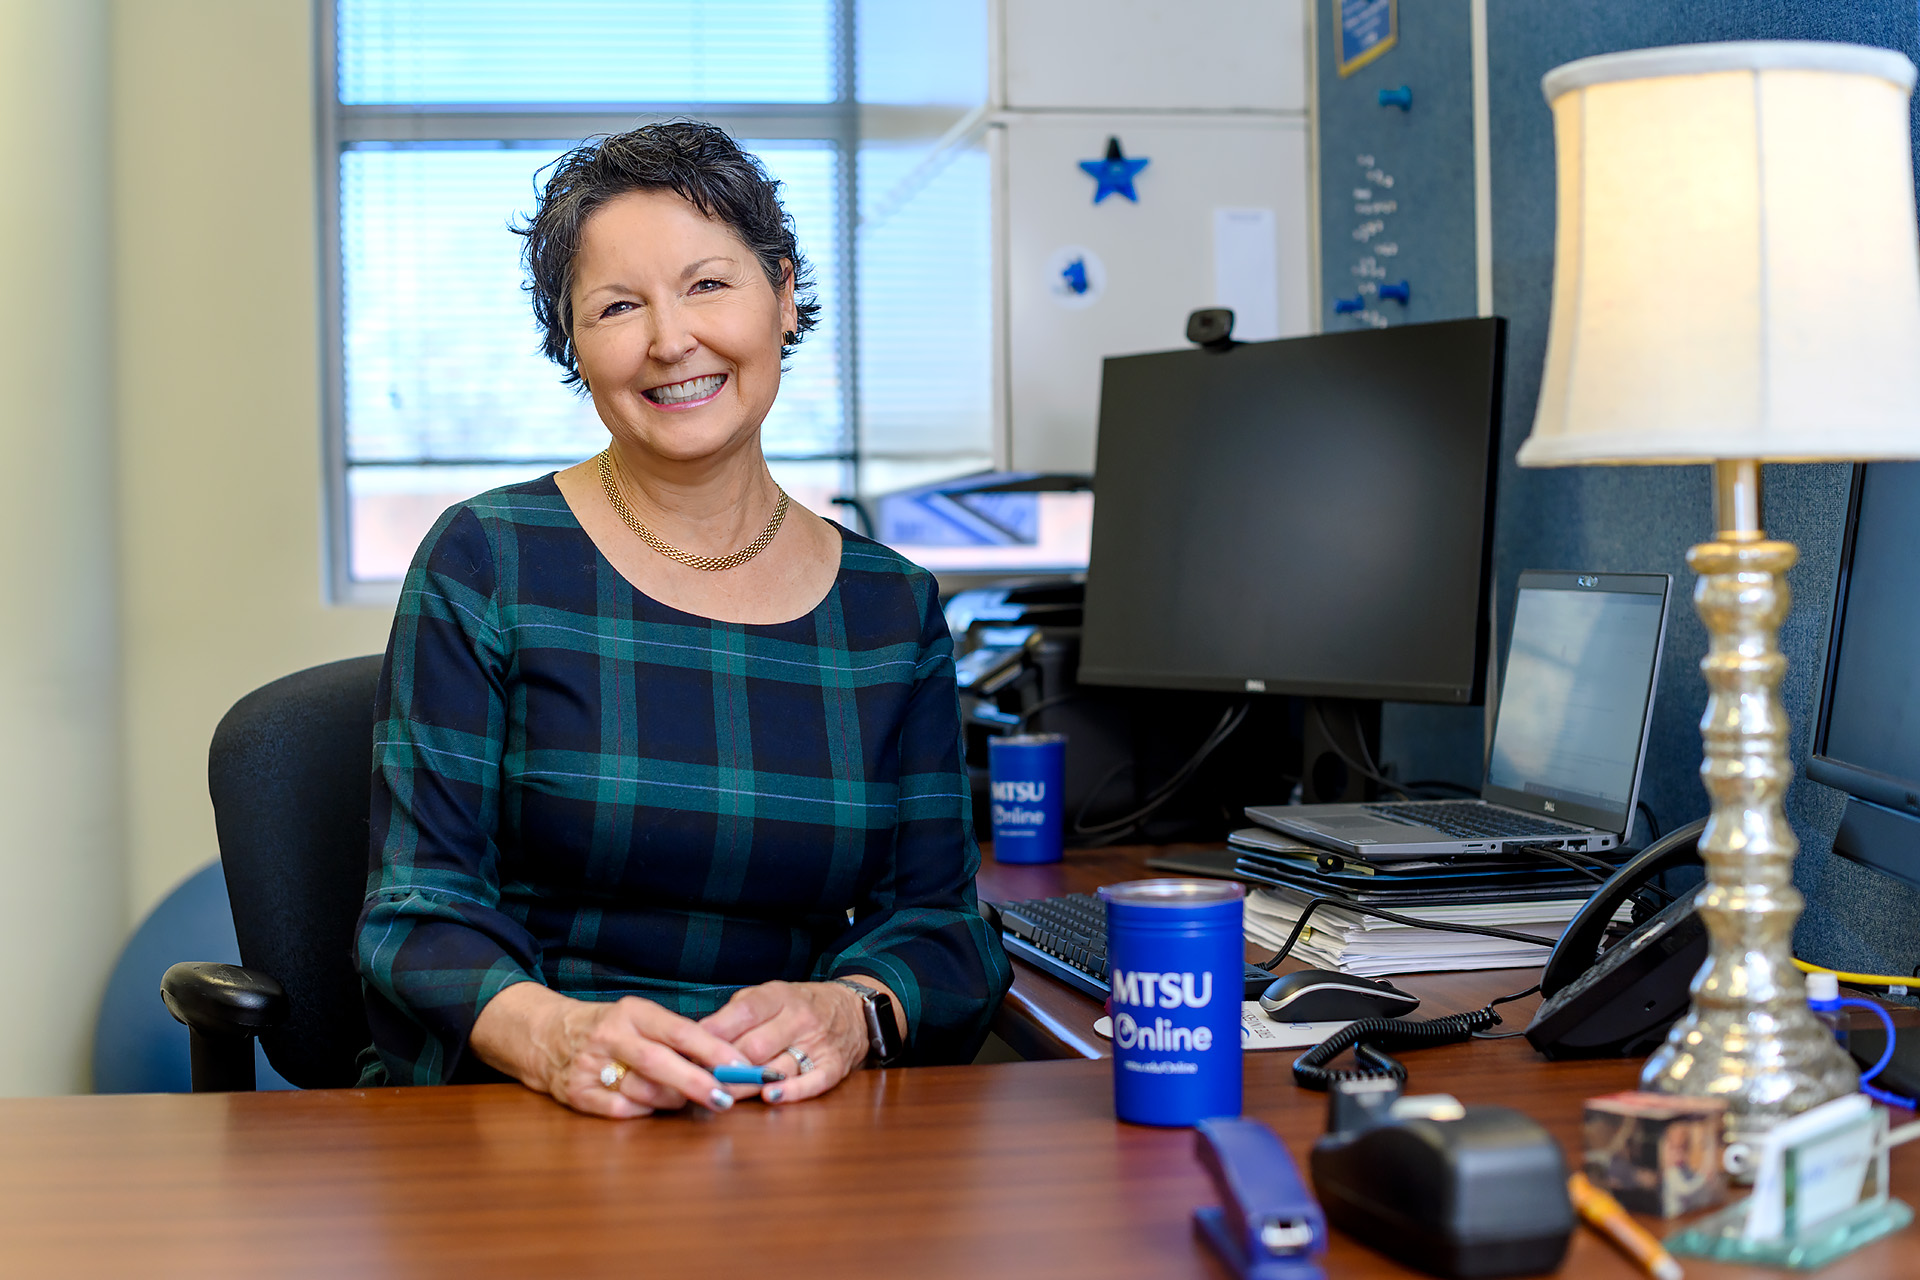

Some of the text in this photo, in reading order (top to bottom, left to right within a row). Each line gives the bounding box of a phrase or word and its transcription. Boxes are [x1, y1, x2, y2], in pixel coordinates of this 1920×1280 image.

[991, 781, 1045, 802] MTSU
[1113, 969, 1212, 1009] MTSU
[1114, 1012, 1213, 1051] Online
